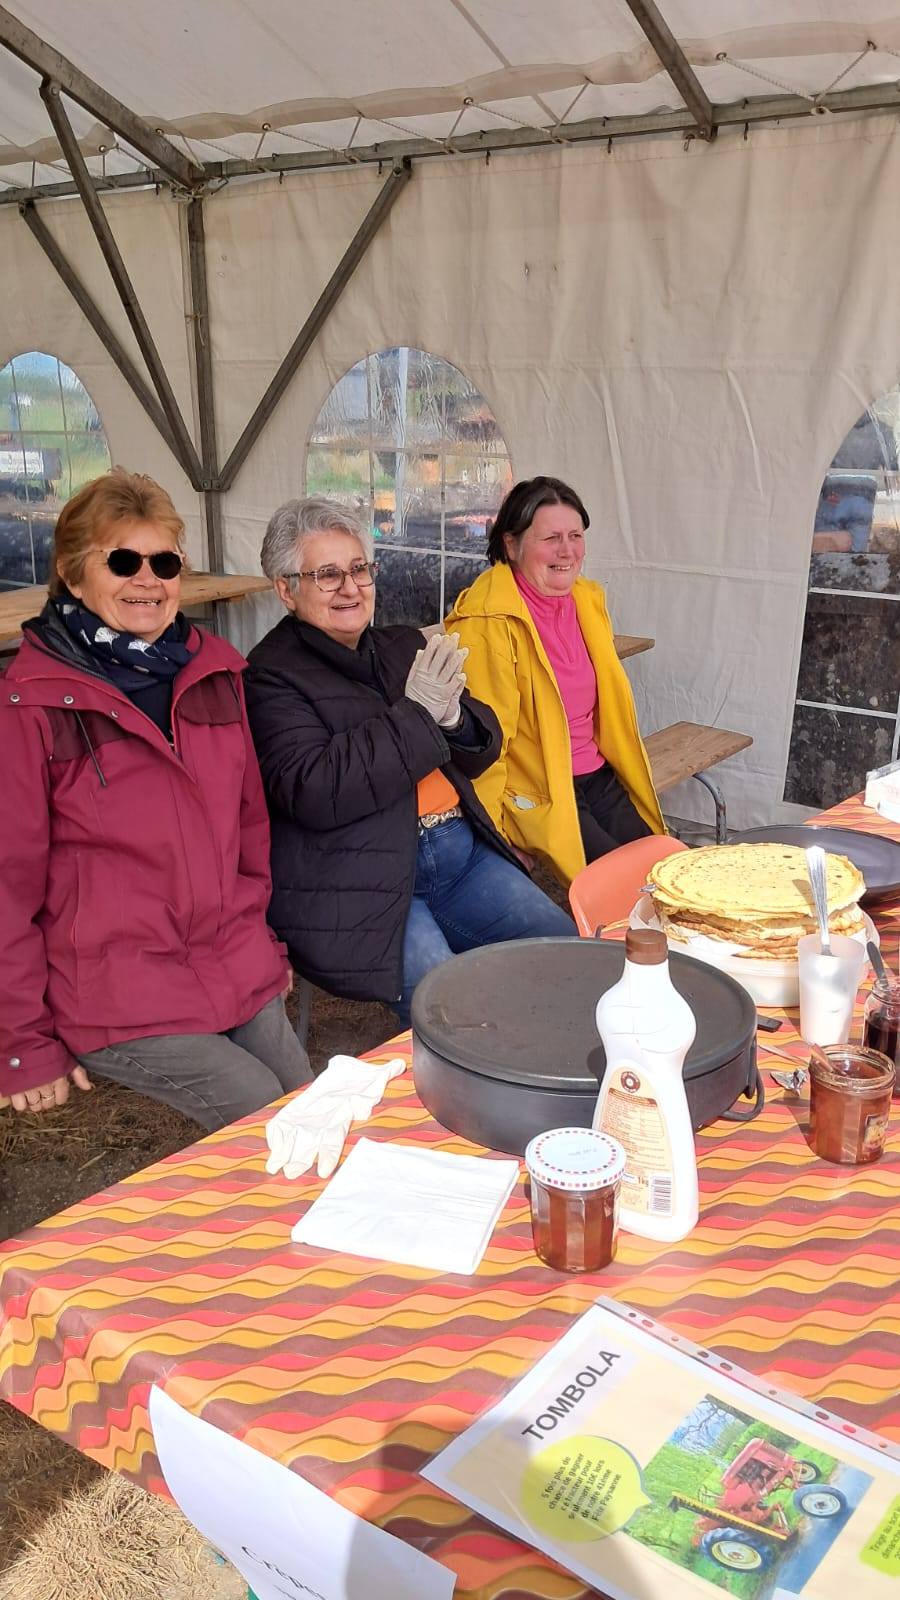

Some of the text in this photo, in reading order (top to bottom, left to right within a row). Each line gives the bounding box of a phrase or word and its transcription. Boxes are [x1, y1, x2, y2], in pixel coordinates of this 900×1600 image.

[521, 1350, 621, 1440] TOMBOLA
[545, 1480, 557, 1494] fois
[554, 1465, 565, 1481] plus
[562, 1456, 571, 1466] de
[549, 1453, 584, 1510] chance de gagner
[567, 1476, 584, 1501] tracteur
[581, 1460, 593, 1477] pour
[593, 1460, 605, 1474] lors
[587, 1491, 600, 1509] notre
[600, 1473, 622, 1506] Paysanne
